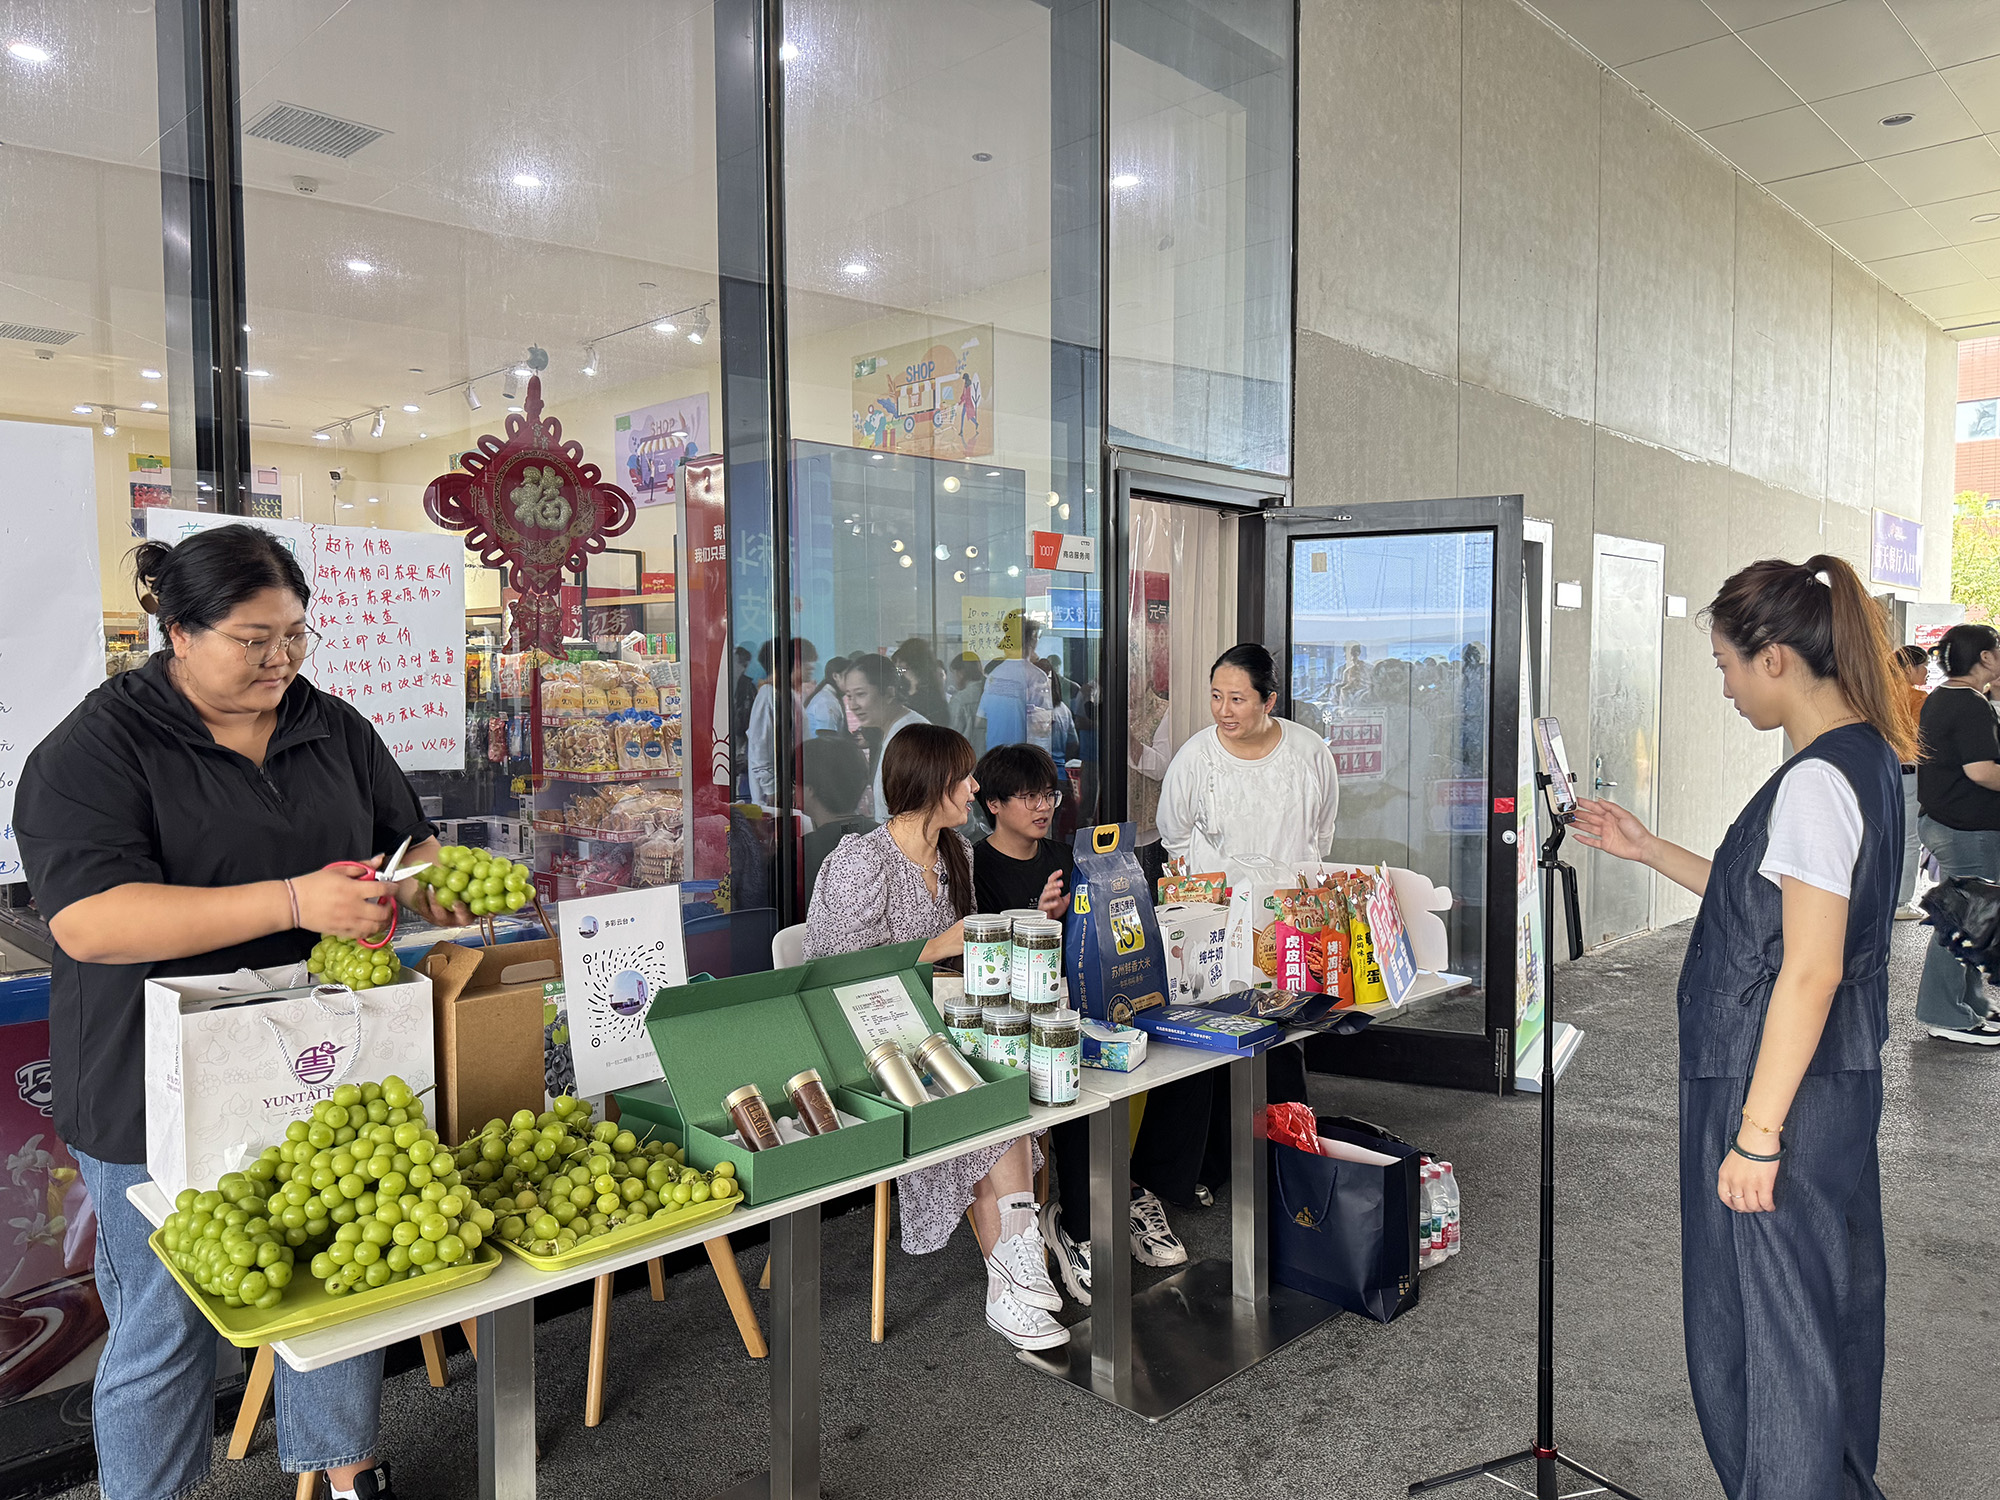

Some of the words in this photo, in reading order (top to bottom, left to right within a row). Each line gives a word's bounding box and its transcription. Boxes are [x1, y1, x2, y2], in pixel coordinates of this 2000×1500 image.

[906, 361, 935, 383] SHOP
[650, 417, 676, 436] SHOP
[509, 465, 573, 531] 福
[1039, 544, 1055, 557] 1007
[604, 917, 629, 929] 多彩云台
[1209, 928, 1225, 945] 浓厚
[1199, 946, 1224, 965] 纯牛奶
[262, 1088, 322, 1109] YUNTAI
